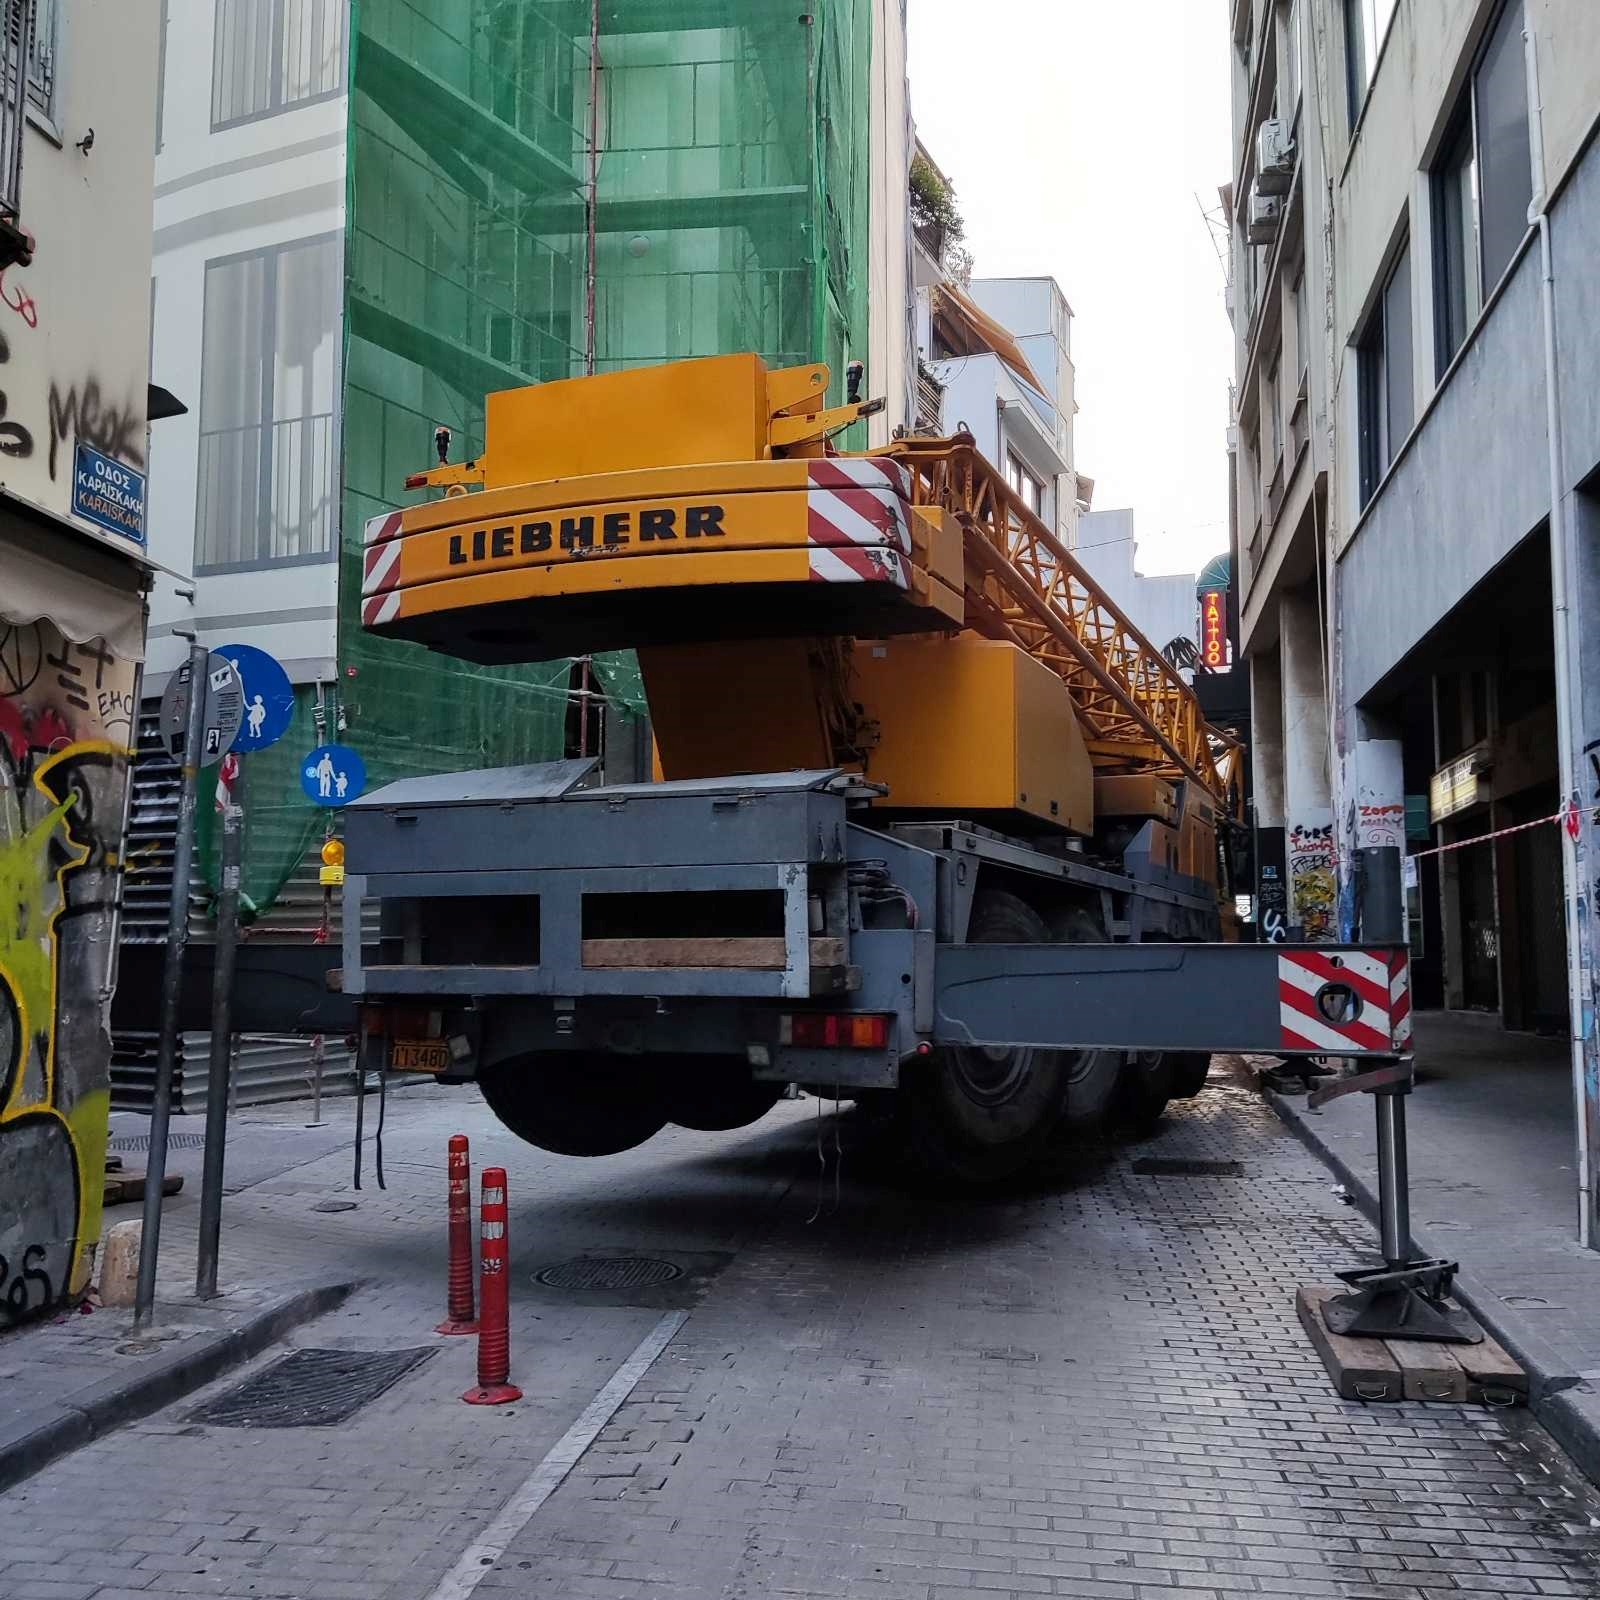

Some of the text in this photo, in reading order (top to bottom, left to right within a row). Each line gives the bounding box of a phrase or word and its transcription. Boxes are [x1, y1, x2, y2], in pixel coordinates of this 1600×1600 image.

[95, 460, 131, 490] ΟΔΟΣ
[79, 490, 143, 531] KARAISKAKI
[449, 505, 726, 565] LIEBHERR
[1207, 593, 1221, 665] TATTOO
